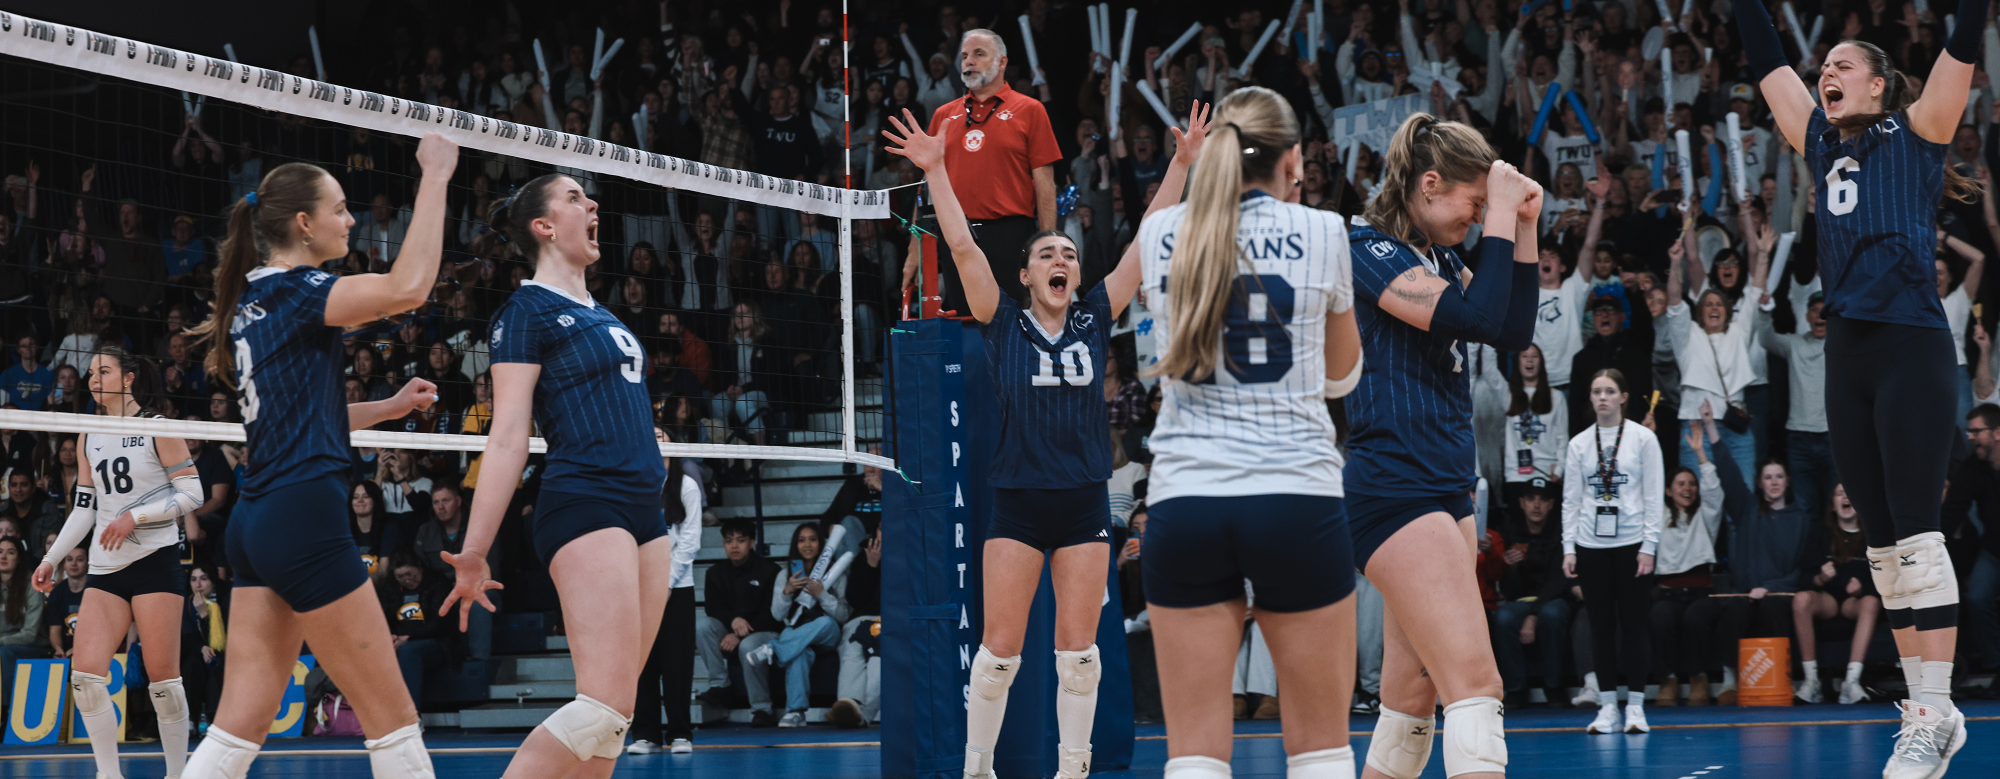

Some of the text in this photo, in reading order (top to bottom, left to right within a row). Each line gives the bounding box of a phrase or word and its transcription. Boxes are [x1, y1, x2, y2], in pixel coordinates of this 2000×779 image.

[1557, 144, 1591, 160] TWU
[1825, 156, 1860, 216] 6
[608, 326, 644, 384] 9
[1030, 340, 1095, 387] 10
[122, 436, 145, 448] UBC
[95, 456, 133, 495] 18
[950, 401, 971, 710] SPARTANS
[11, 663, 65, 742] U
